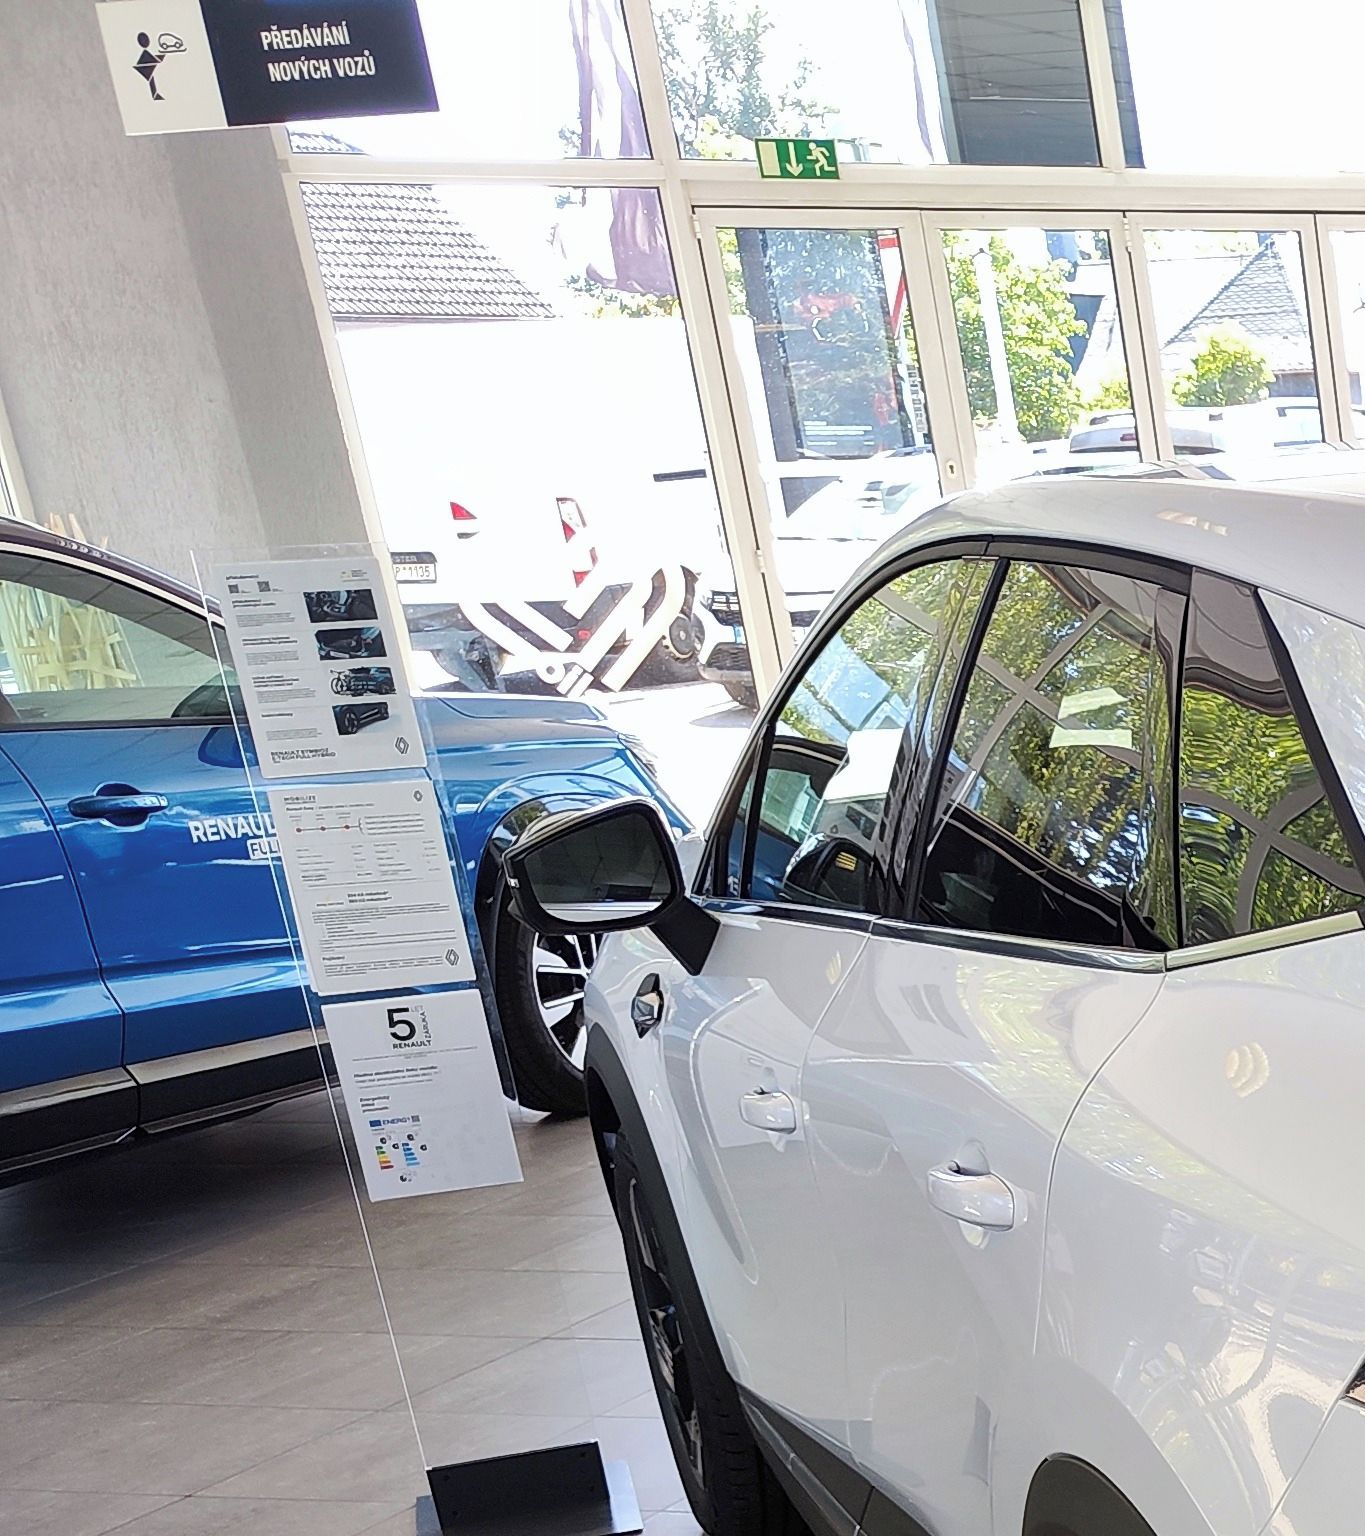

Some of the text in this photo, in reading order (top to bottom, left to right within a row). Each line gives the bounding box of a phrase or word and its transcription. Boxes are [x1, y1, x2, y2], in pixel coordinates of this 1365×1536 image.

[260, 20, 351, 51] PŘEDÁVÁNÍ
[267, 49, 376, 82] NOVÝCH VOZŮ
[188, 814, 278, 843] RENAUL
[386, 1007, 417, 1042] 5
[392, 1039, 432, 1050] RENAULT
